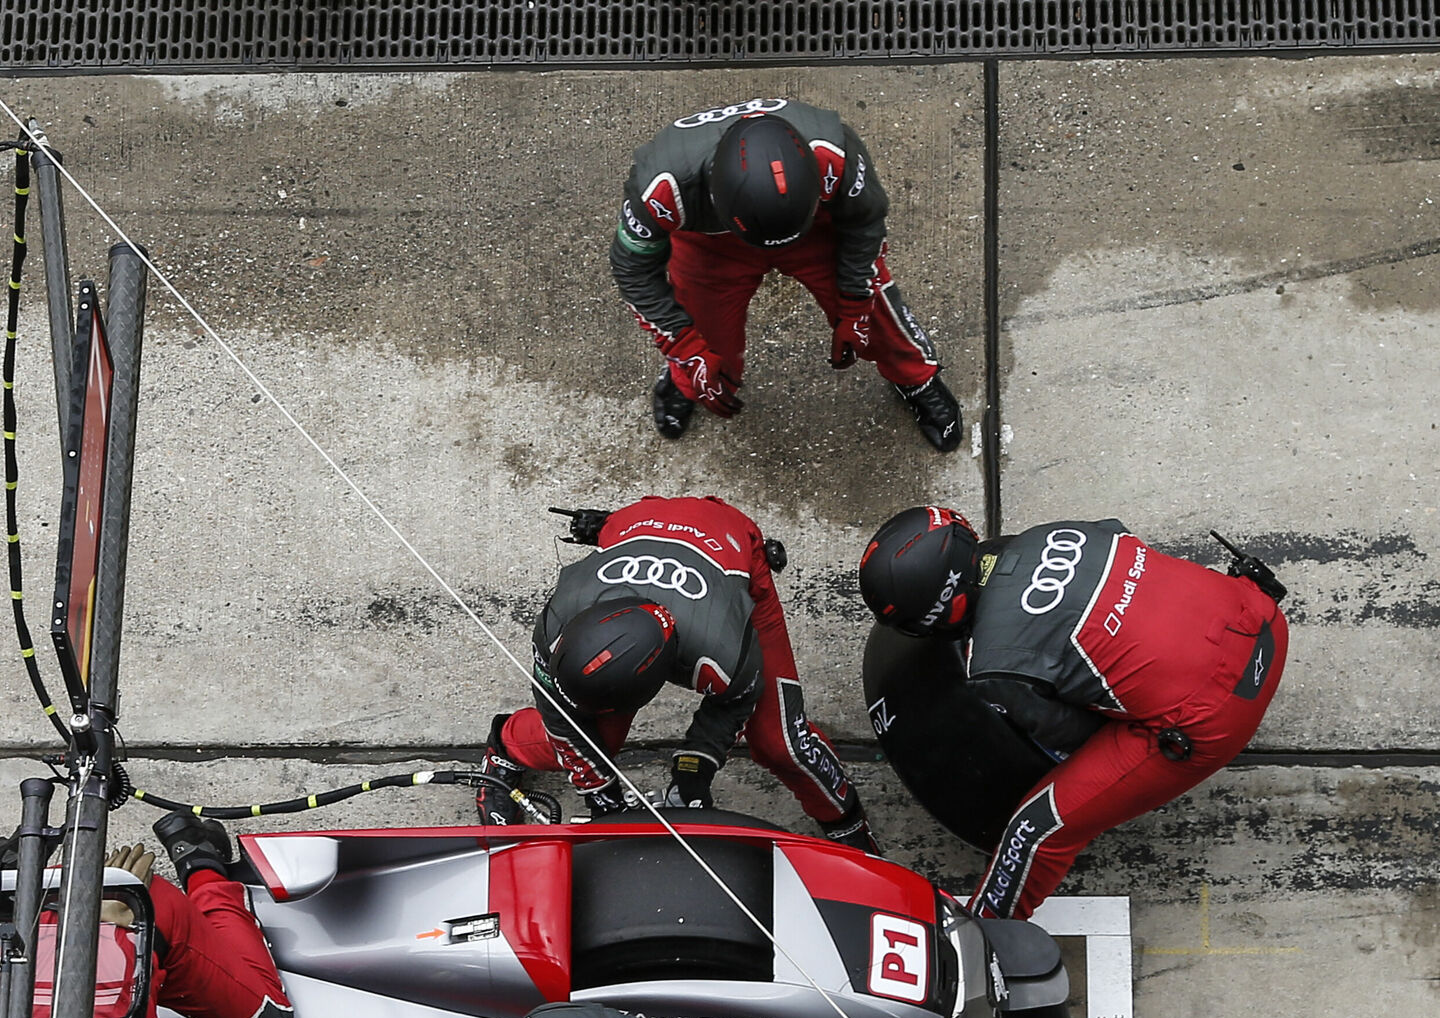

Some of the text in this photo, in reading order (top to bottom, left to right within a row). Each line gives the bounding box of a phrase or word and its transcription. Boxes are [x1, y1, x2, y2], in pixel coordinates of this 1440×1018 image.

[666, 523, 706, 538] Audi
[920, 569, 963, 627] uvex
[1114, 546, 1147, 616] Audi Sport
[987, 819, 1036, 909] Audi Sport
[881, 928, 919, 987] P1
